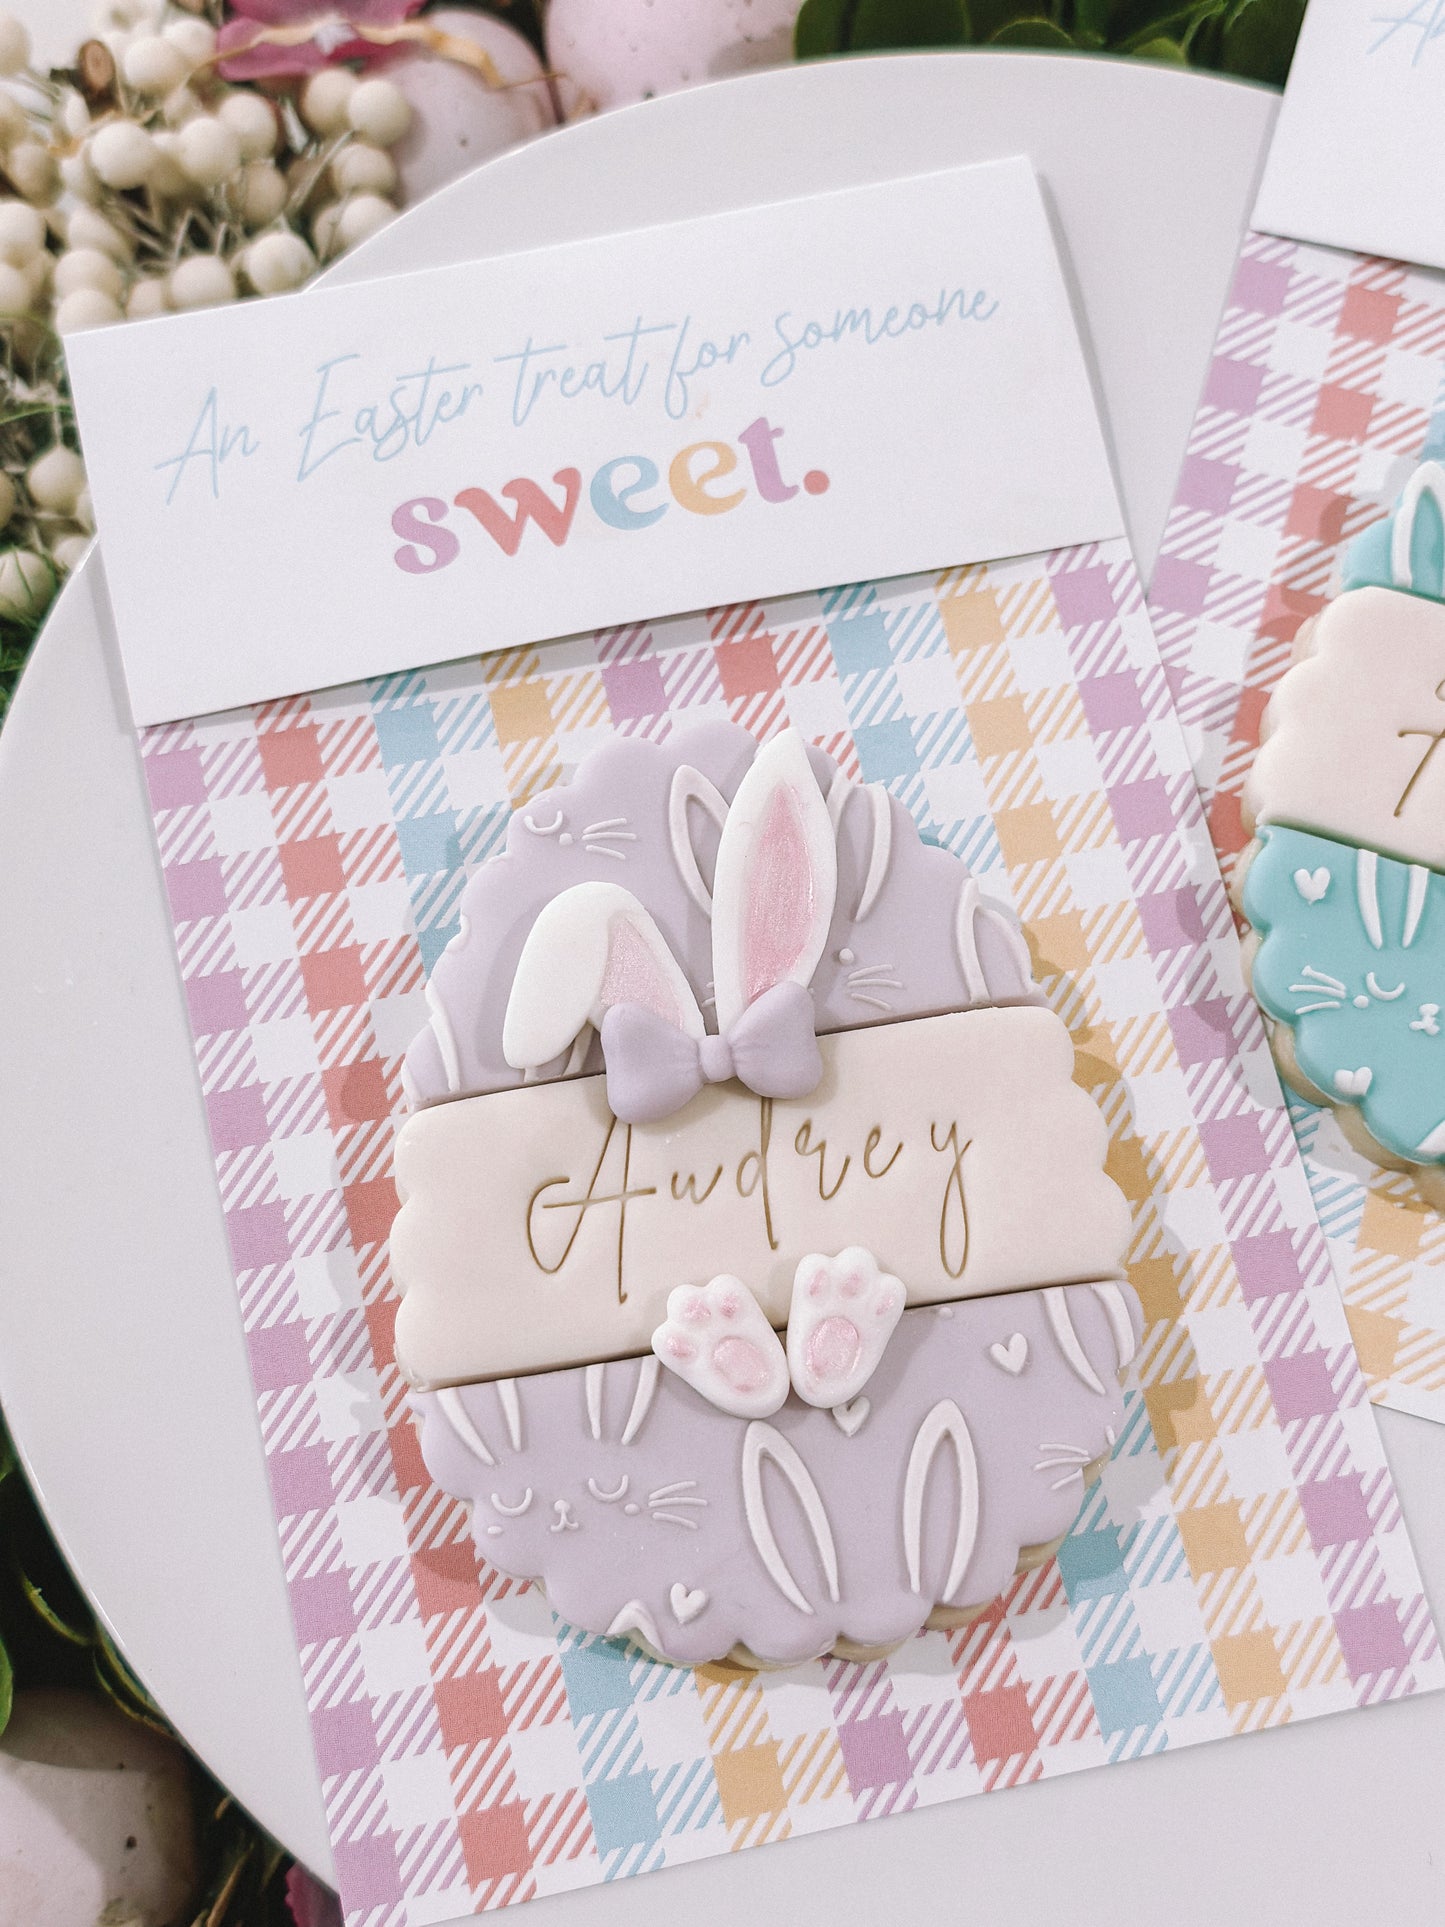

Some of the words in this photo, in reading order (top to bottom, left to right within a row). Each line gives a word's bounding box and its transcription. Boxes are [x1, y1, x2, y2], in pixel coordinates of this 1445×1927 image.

[154, 386, 261, 505] An
[297, 353, 485, 482] Easter
[494, 317, 677, 427] treat
[665, 315, 752, 419] for
[760, 287, 1001, 386] someone
[390, 416, 832, 575] sweet.
[526, 1097, 973, 1304] Audrey
